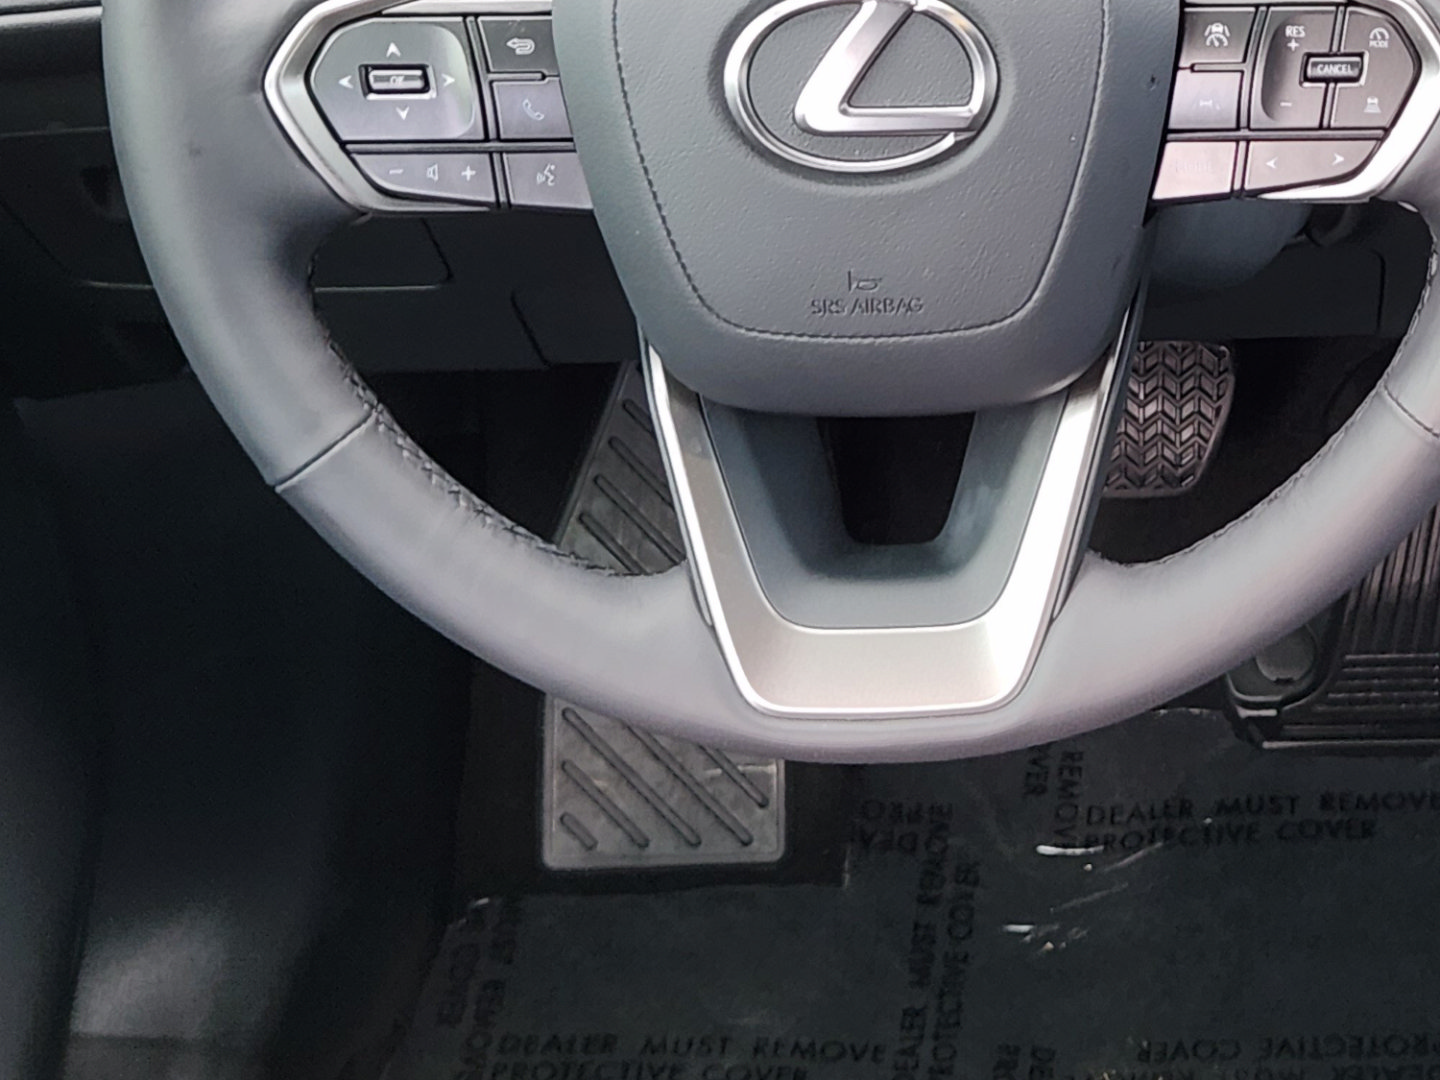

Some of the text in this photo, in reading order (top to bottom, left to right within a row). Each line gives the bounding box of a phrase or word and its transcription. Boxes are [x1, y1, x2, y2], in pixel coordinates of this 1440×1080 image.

[1285, 25, 1305, 38] RES
[1316, 64, 1353, 74] CANCEL
[811, 297, 924, 316] SRS AIRBAG
[1087, 795, 1195, 826] DEALER
[1215, 794, 1300, 818] MUST
[1276, 819, 1379, 842] COVER
[497, 1032, 887, 1063] DEALER MUST REMOVE
